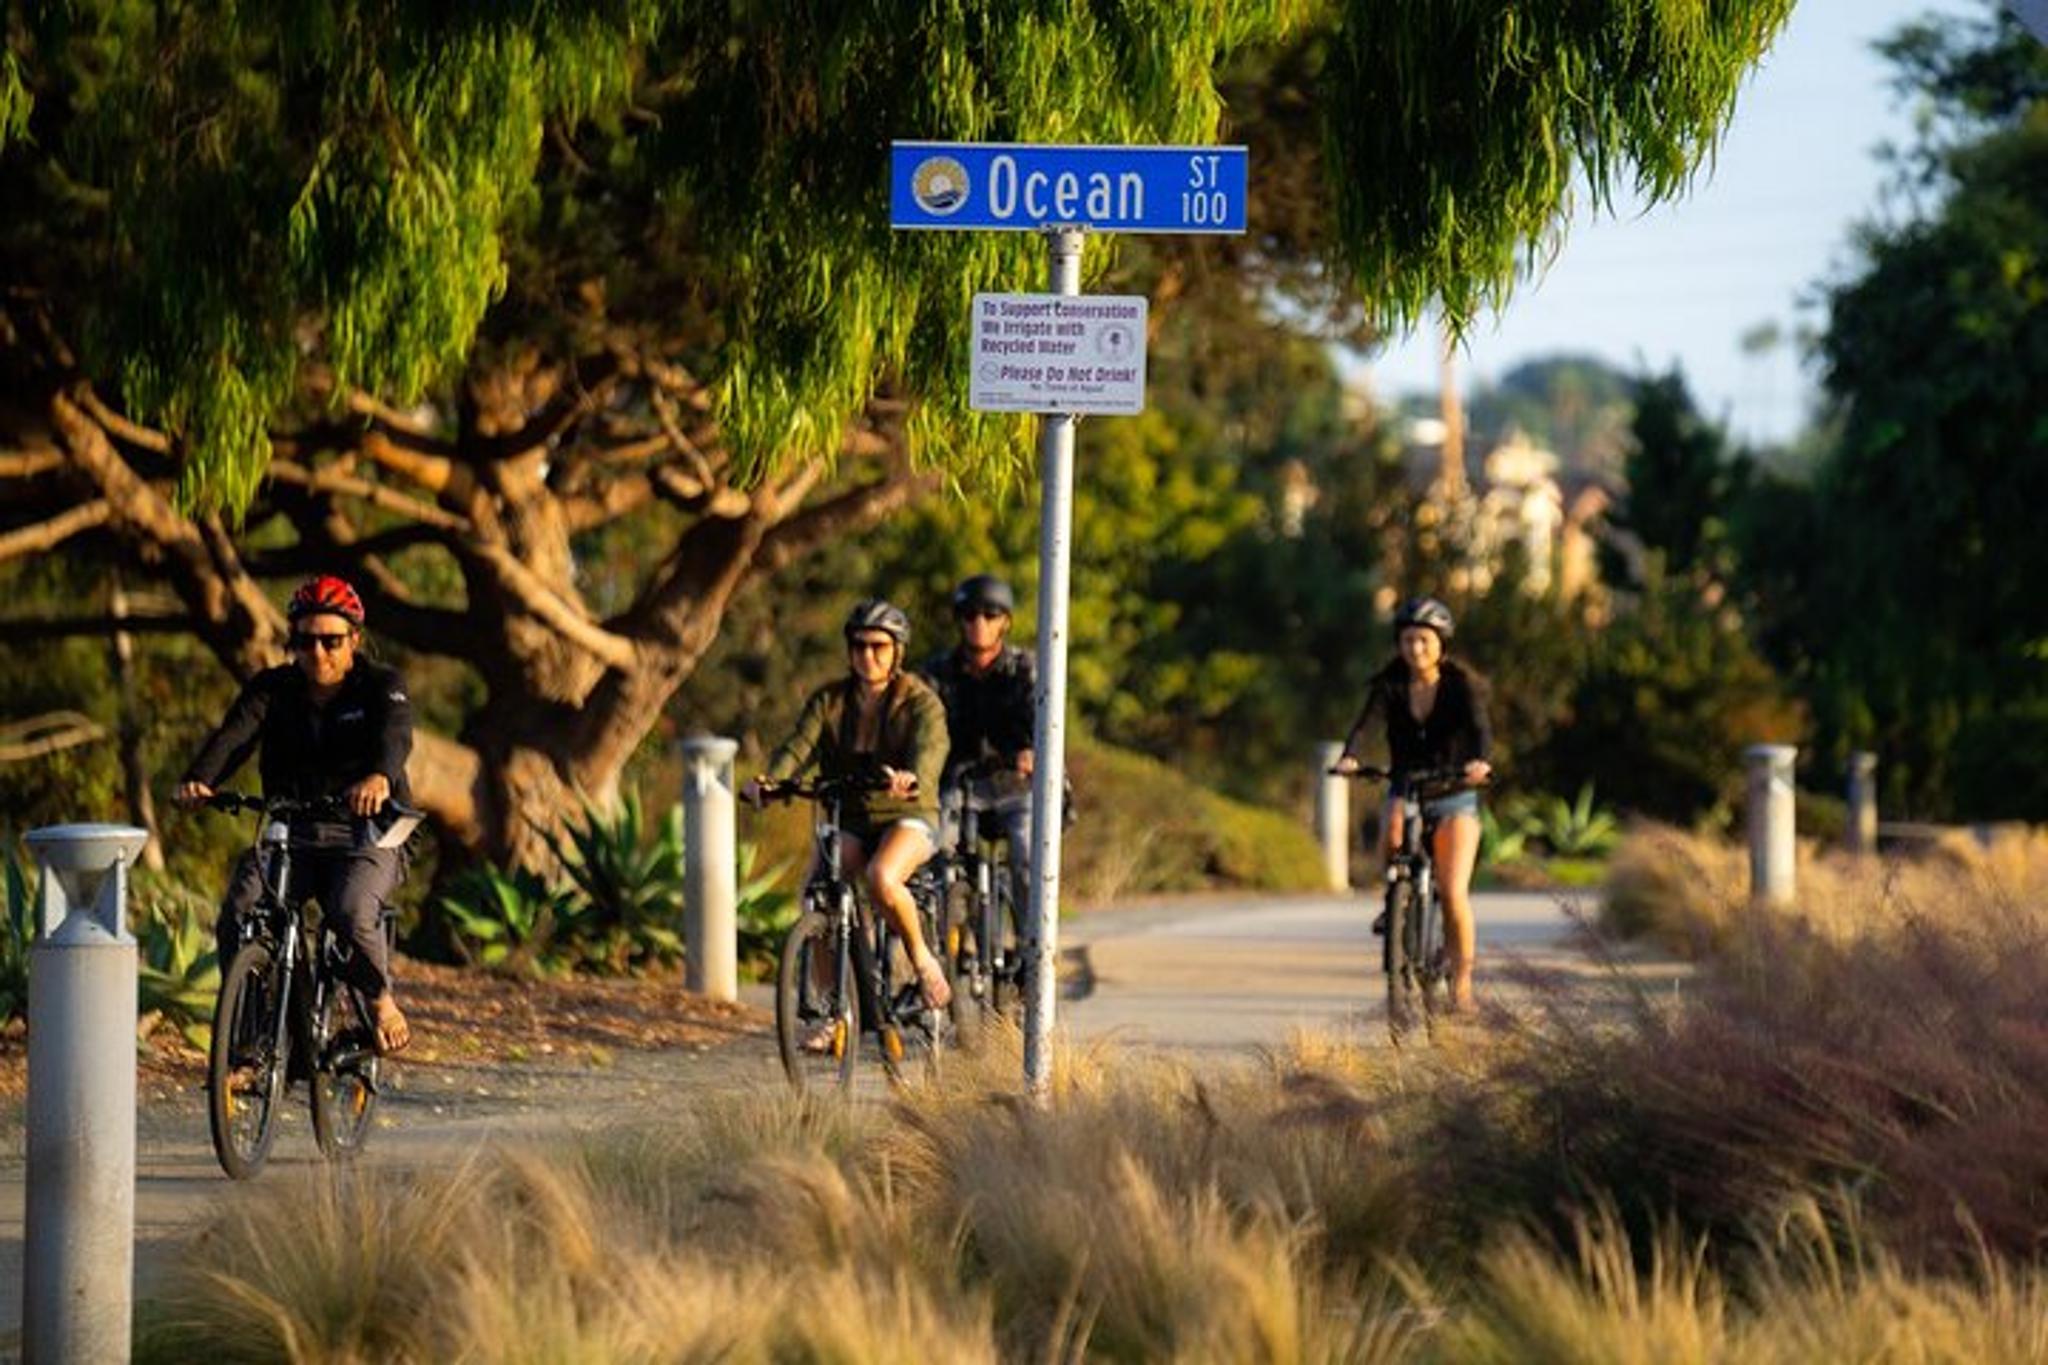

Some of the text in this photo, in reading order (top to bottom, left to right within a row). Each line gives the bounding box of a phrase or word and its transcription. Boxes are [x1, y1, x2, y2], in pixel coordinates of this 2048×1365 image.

[1189, 155, 1220, 188] ST
[988, 155, 1145, 220] Ocean
[1182, 191, 1228, 225] 100
[983, 301, 1138, 319] To Support Conservation
[1004, 321, 1051, 337] Irrigate
[1056, 321, 1085, 336] with
[981, 338, 1076, 355] Recycled Water
[1001, 365, 1137, 382] Please Do Not Drink!
